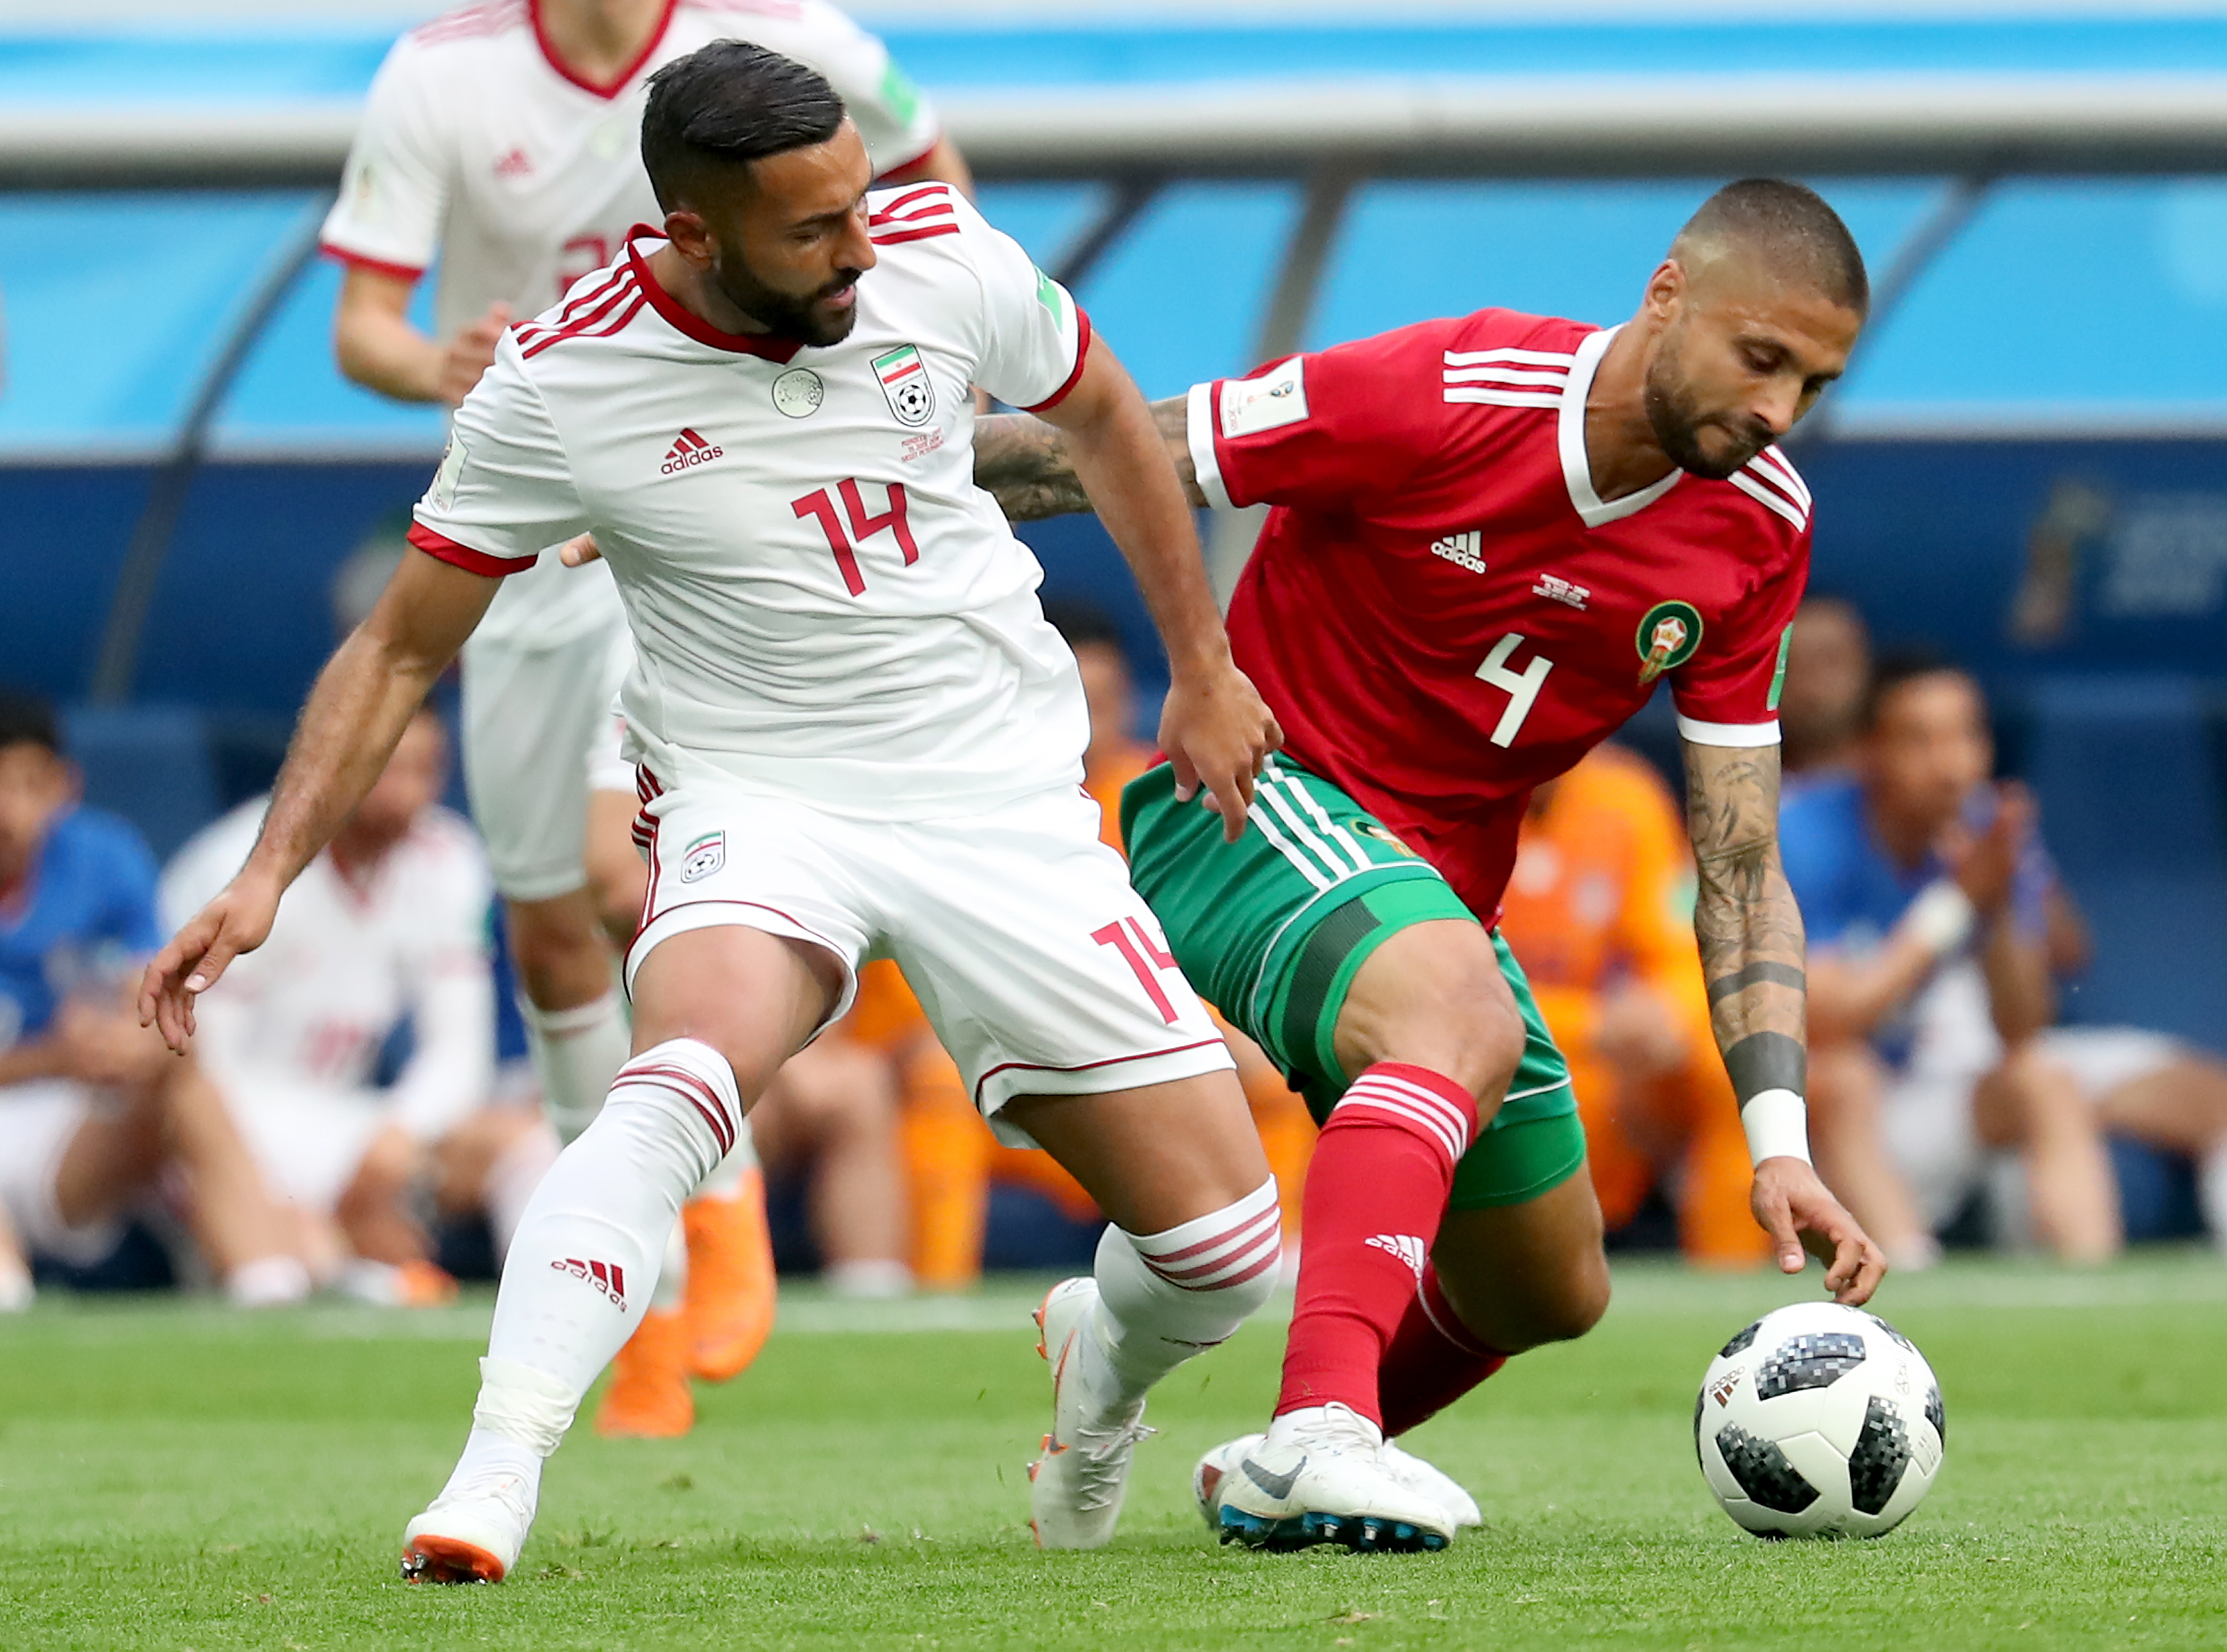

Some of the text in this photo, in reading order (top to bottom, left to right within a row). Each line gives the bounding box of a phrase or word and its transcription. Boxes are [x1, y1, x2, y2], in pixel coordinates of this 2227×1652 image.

[661, 446, 724, 474] adidas
[790, 477, 919, 597] 14
[1430, 541, 1487, 575] adidas
[1475, 632, 1554, 748] 4
[550, 1260, 628, 1312] adidas
